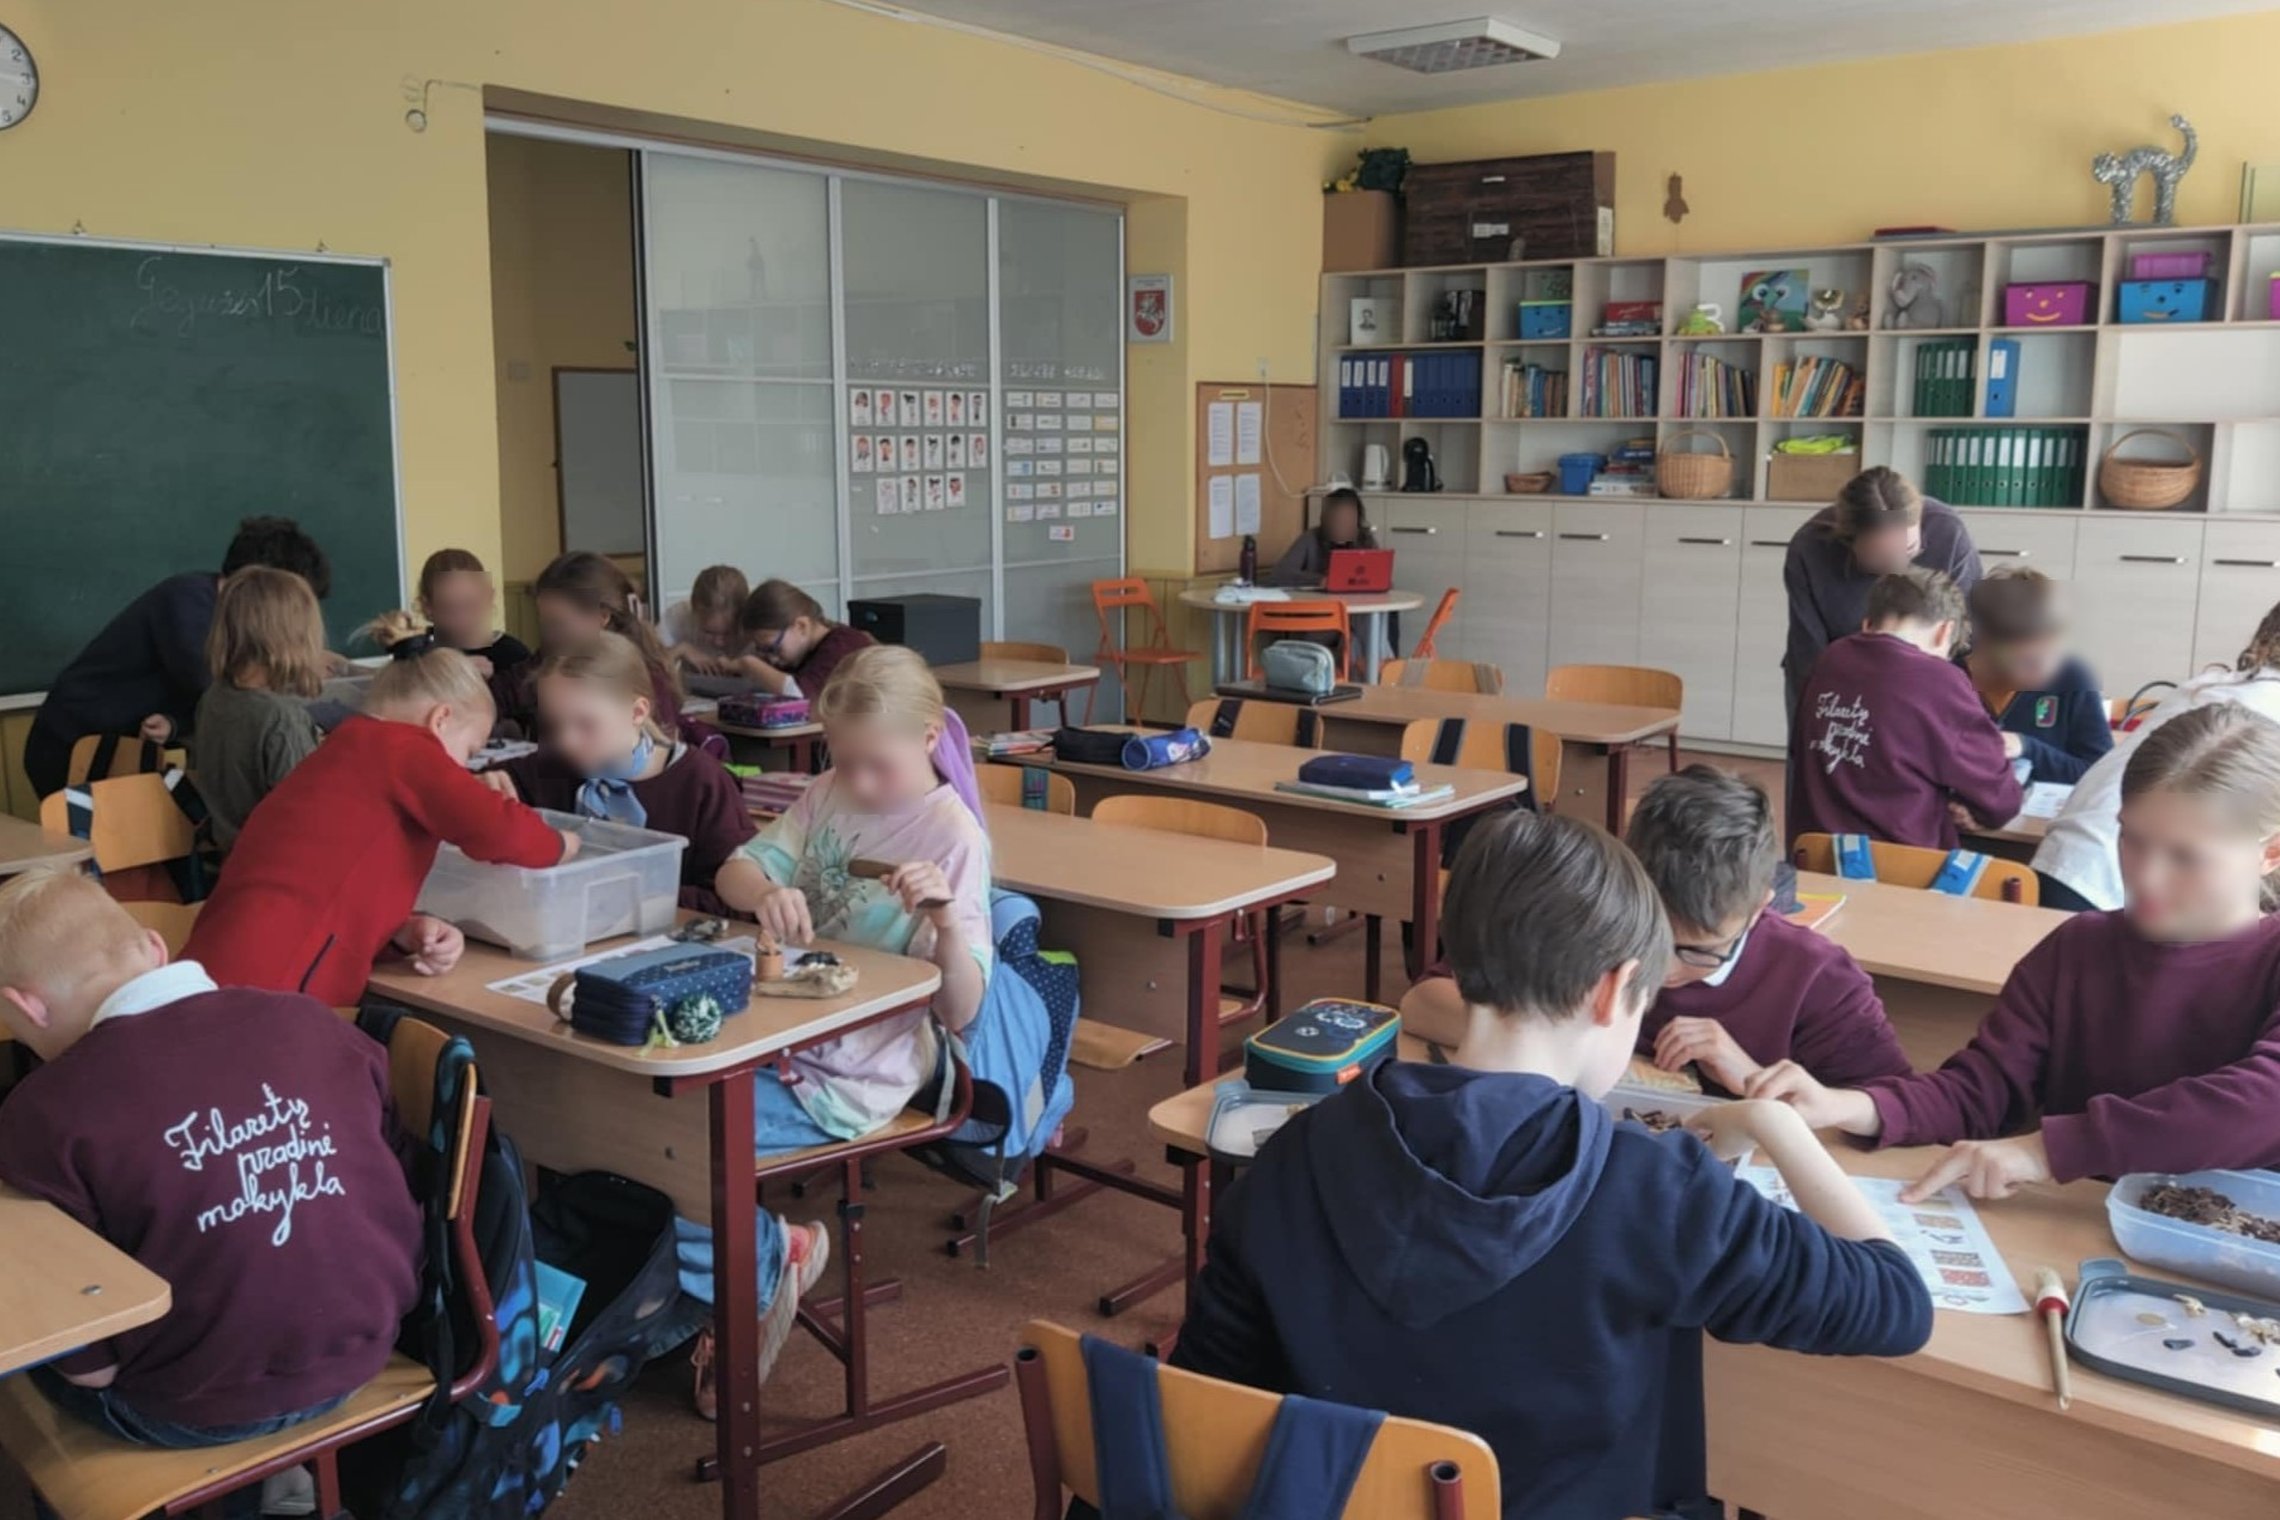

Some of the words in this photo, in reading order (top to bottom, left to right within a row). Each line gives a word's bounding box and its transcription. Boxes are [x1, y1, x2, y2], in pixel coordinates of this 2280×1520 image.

[11, 48, 22, 62] 2
[17, 94, 26, 107] 4
[261, 265, 303, 316] 15
[197, 1160, 346, 1247] mokykla
